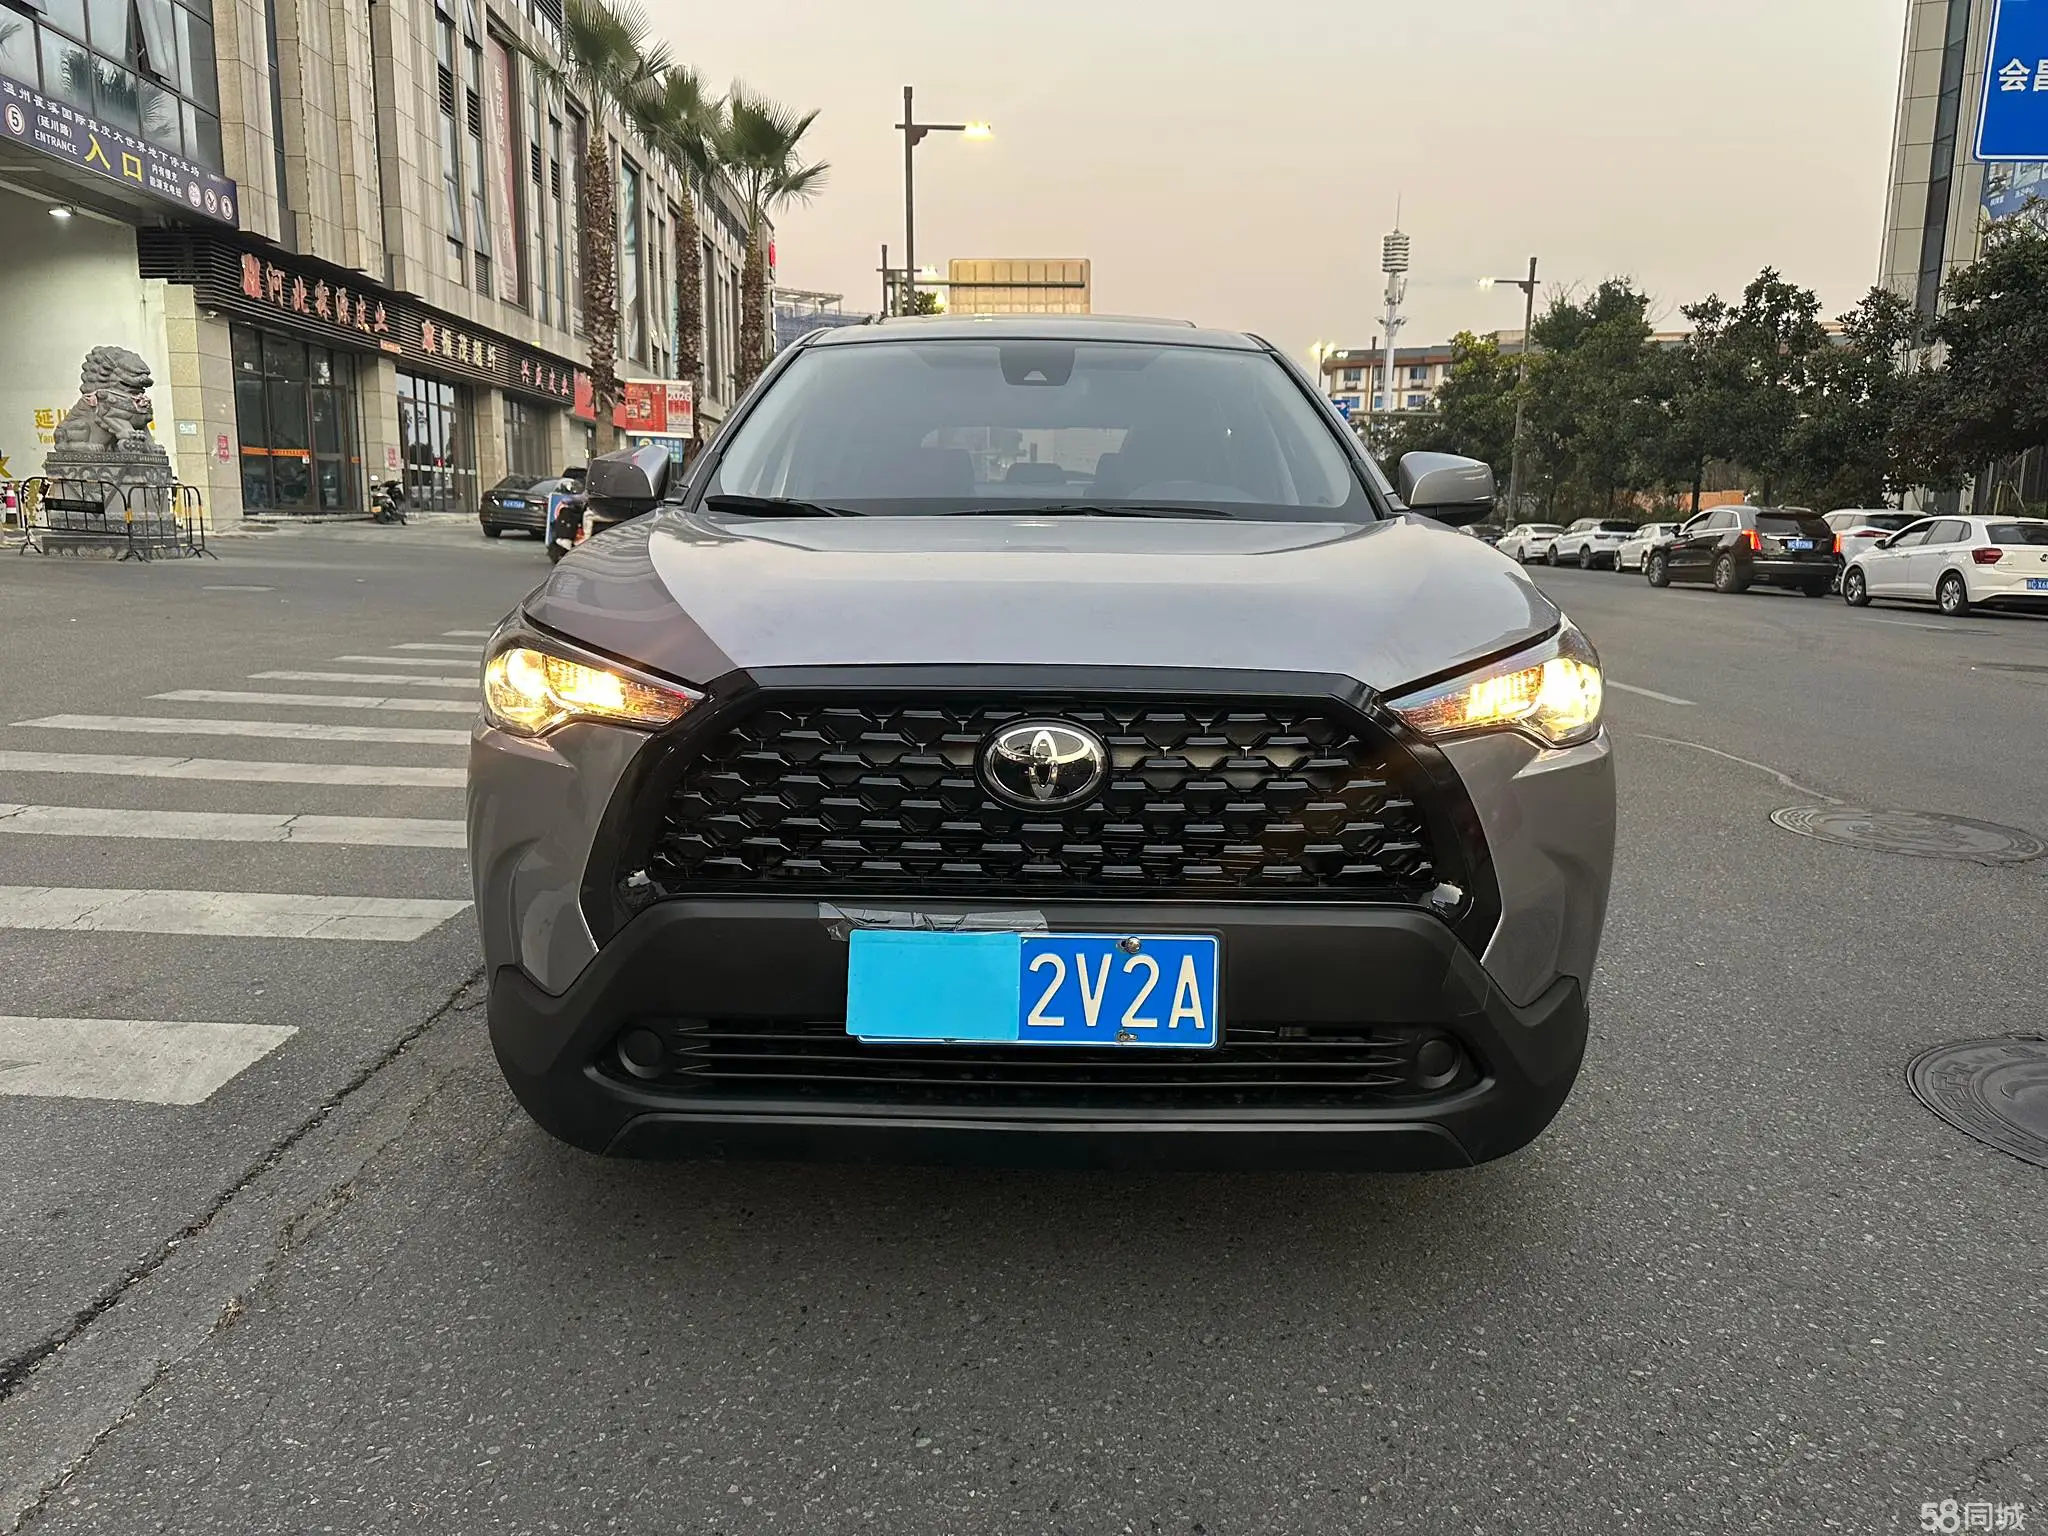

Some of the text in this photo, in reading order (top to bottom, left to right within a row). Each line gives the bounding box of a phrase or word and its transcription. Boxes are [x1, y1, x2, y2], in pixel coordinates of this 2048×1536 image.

[34, 128, 78, 155] ENTRANCE
[84, 133, 142, 182] 入口
[667, 391, 692, 402] 2026
[1027, 952, 1206, 1029] 2V2A
